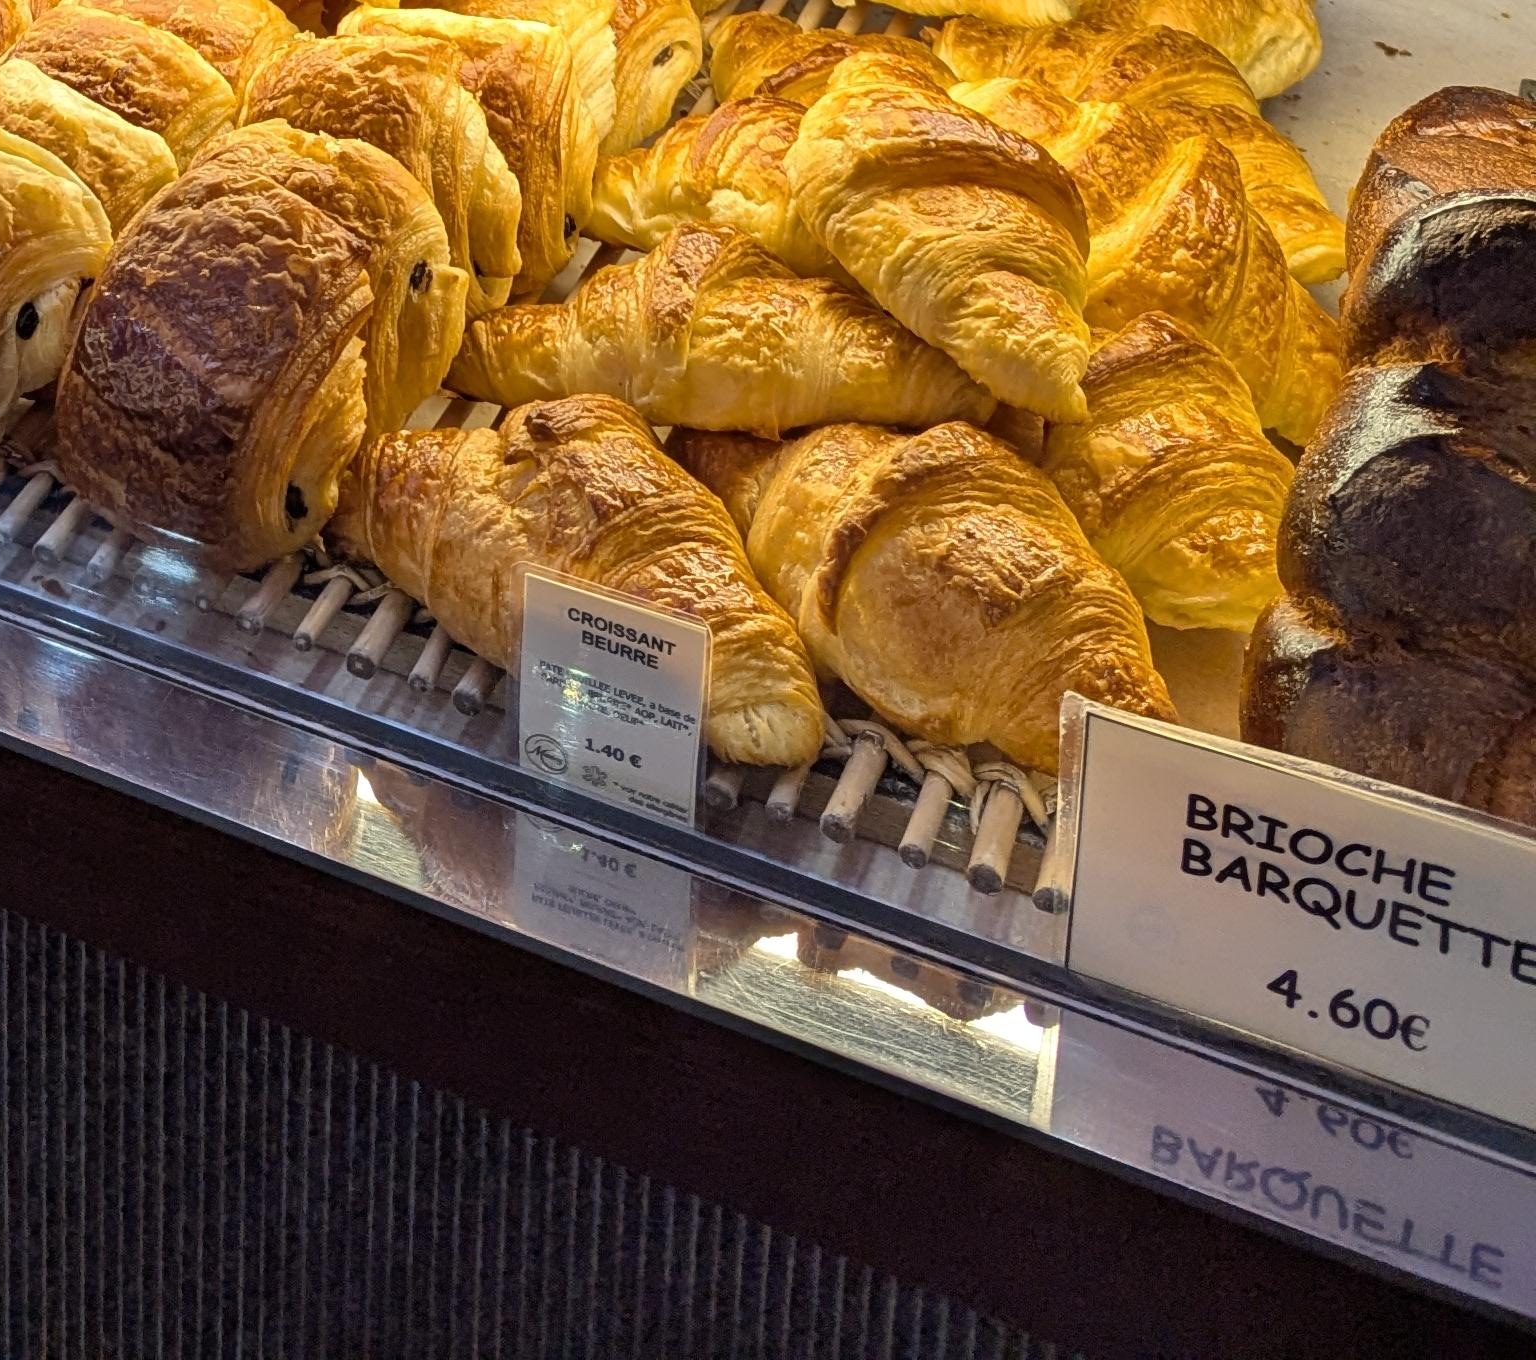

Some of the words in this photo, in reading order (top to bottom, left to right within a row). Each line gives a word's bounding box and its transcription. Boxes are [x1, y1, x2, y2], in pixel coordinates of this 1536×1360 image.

[567, 606, 677, 656] CROISSANT
[581, 629, 660, 670] BEURRE
[585, 738, 625, 762] 1.40
[628, 754, 642, 769] €
[1186, 792, 1457, 907] BRIOCHE
[1180, 837, 1536, 983] BARQUETTE
[1266, 968, 1432, 1052] 4.60€
